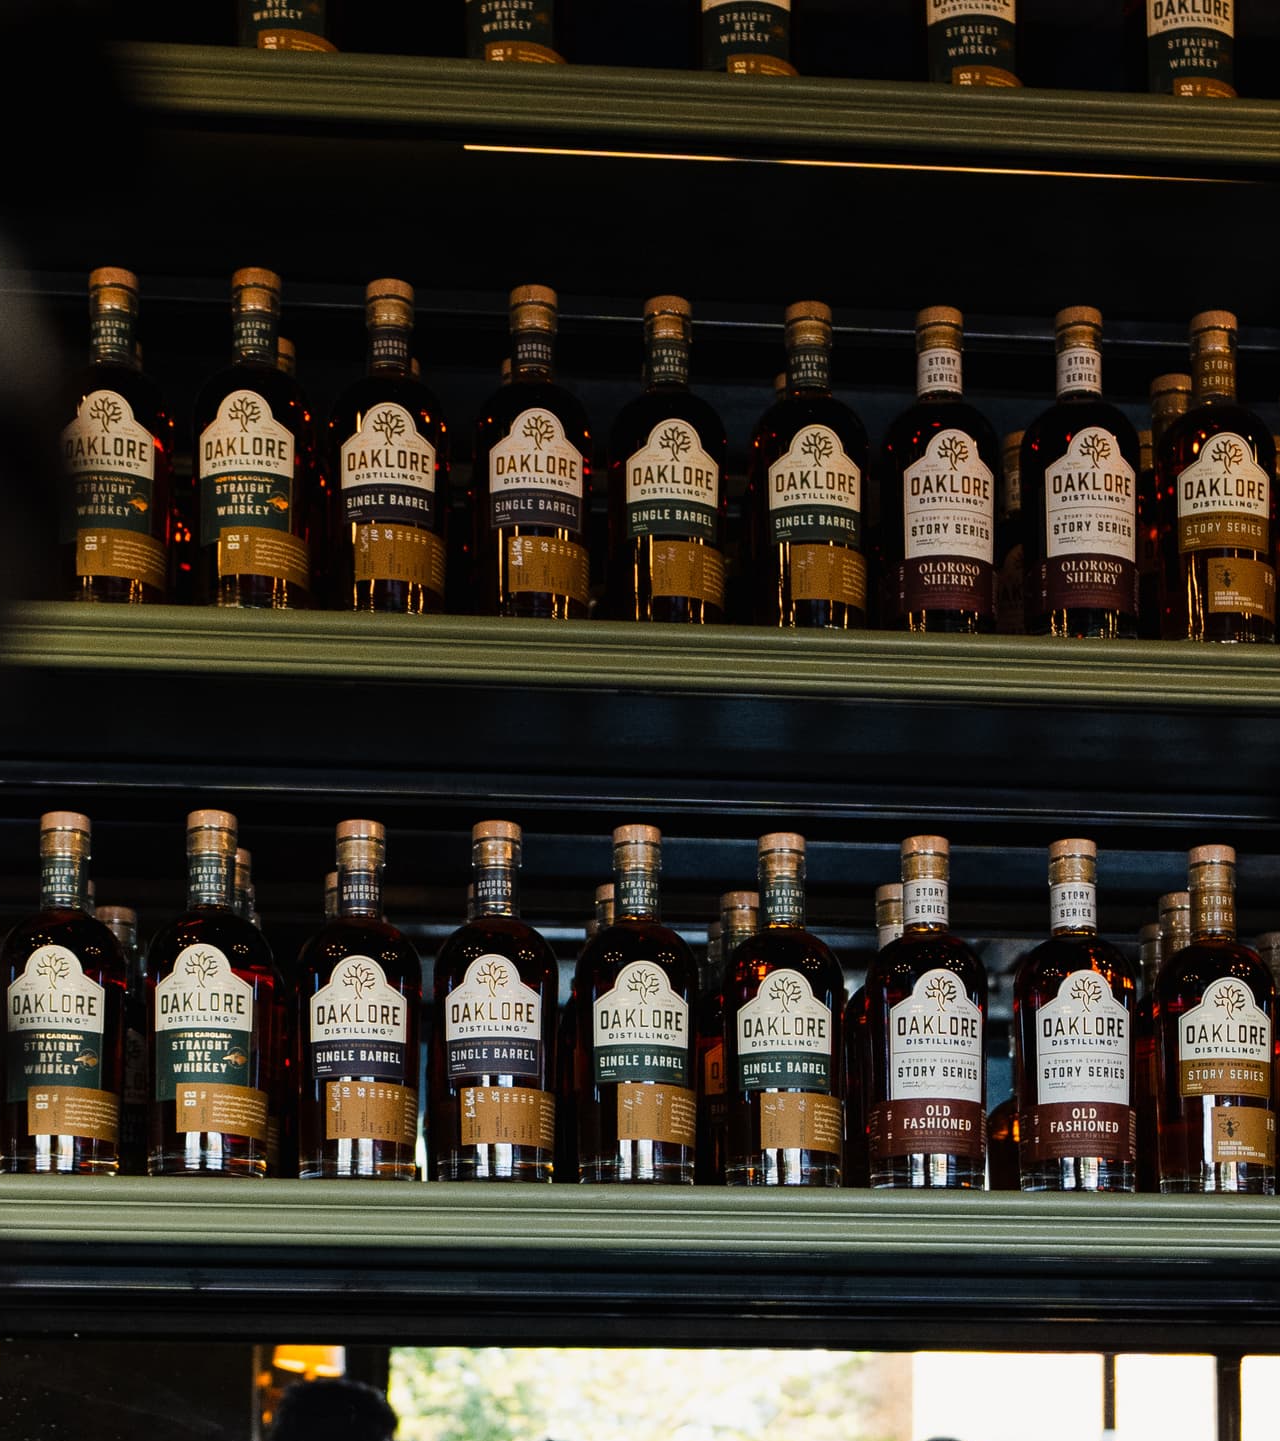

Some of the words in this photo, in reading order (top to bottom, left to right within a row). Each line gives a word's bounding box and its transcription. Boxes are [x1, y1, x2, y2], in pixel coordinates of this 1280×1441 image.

[1154, 0, 1229, 20] OAKLORE
[946, 26, 998, 38] STRAIGHT
[962, 35, 982, 44] RYE
[1168, 40, 1219, 50] STRAIGHT
[948, 45, 997, 57] WHISKEY
[1184, 48, 1203, 57] RYE
[1170, 59, 1218, 70] WHISKEY
[205, 437, 287, 461] OAKLORE
[347, 449, 430, 475] OAKLORE
[496, 454, 577, 480] OAKLORE
[633, 465, 713, 491] OAKLORE
[776, 470, 856, 495] OAKLORE
[216, 484, 272, 494] STRAIGHT
[910, 474, 990, 500] OAKLORE
[1053, 473, 1131, 498] OAKLORE
[1185, 478, 1264, 502] OAKLORE
[232, 494, 253, 504] RYE
[347, 494, 384, 509] SINGLE
[390, 494, 429, 512] BARREL
[217, 506, 269, 517] WHISKEY
[496, 499, 533, 513] SINGLE
[539, 500, 576, 517] BARREL
[632, 510, 670, 523] SINGLE
[676, 510, 712, 527] BARREL
[776, 515, 813, 530] SINGLE
[819, 515, 855, 531] BARREL
[912, 523, 948, 537] STORY
[955, 524, 990, 541] SERIES
[1054, 522, 1090, 536] STORY
[1098, 522, 1131, 539] SERIES
[1186, 523, 1221, 536] STORY
[1227, 523, 1262, 537] SERIES
[919, 561, 980, 576] OLOROSO
[1062, 560, 1122, 574] OLOROSO
[924, 574, 975, 587] SHERRY
[1067, 573, 1118, 586] SHERRY
[916, 887, 944, 897] STORY
[1061, 891, 1089, 900] STORY
[1203, 896, 1231, 905] STORY
[915, 905, 945, 915] SERIES
[1060, 908, 1091, 918] SERIES
[1201, 912, 1232, 922] SERIES
[13, 994, 97, 1016] OAKLORE
[161, 993, 245, 1015] OAKLORE
[317, 1004, 400, 1026] OAKLORE
[452, 1001, 534, 1023] OAKLORE
[601, 1009, 682, 1031] OAKLORE
[898, 1016, 977, 1038] OAKLORE
[744, 1017, 825, 1038] OAKLORE
[1043, 1017, 1124, 1038] OAKLORE
[1186, 1024, 1266, 1047] OAKLORE
[24, 1041, 80, 1052] STRAIGHT
[172, 1040, 229, 1051] STRAIGHT
[40, 1053, 62, 1062] RYE
[188, 1051, 211, 1061] RYE
[316, 1050, 354, 1063] SINGLE
[360, 1050, 401, 1064] BARREL
[451, 1048, 488, 1061] SINGLE
[494, 1047, 535, 1061] BARREL
[173, 1062, 227, 1073] WHISKEY
[600, 1055, 639, 1067] SINGLE
[644, 1055, 682, 1069] BARREL
[744, 1062, 781, 1074] SINGLE
[787, 1062, 825, 1075] BARREL
[24, 1064, 78, 1075] WHISKEY
[898, 1066, 935, 1078] STORY
[942, 1066, 977, 1080] SERIES
[1044, 1067, 1081, 1079] STORY
[1088, 1067, 1125, 1080] SERIES
[1188, 1069, 1223, 1081] STORY
[1230, 1069, 1264, 1082] SERIES
[925, 1105, 950, 1116] OLD
[1072, 1108, 1096, 1119] OLD
[904, 1118, 971, 1131] FASHIONED
[1050, 1120, 1119, 1133] FASHIONED
